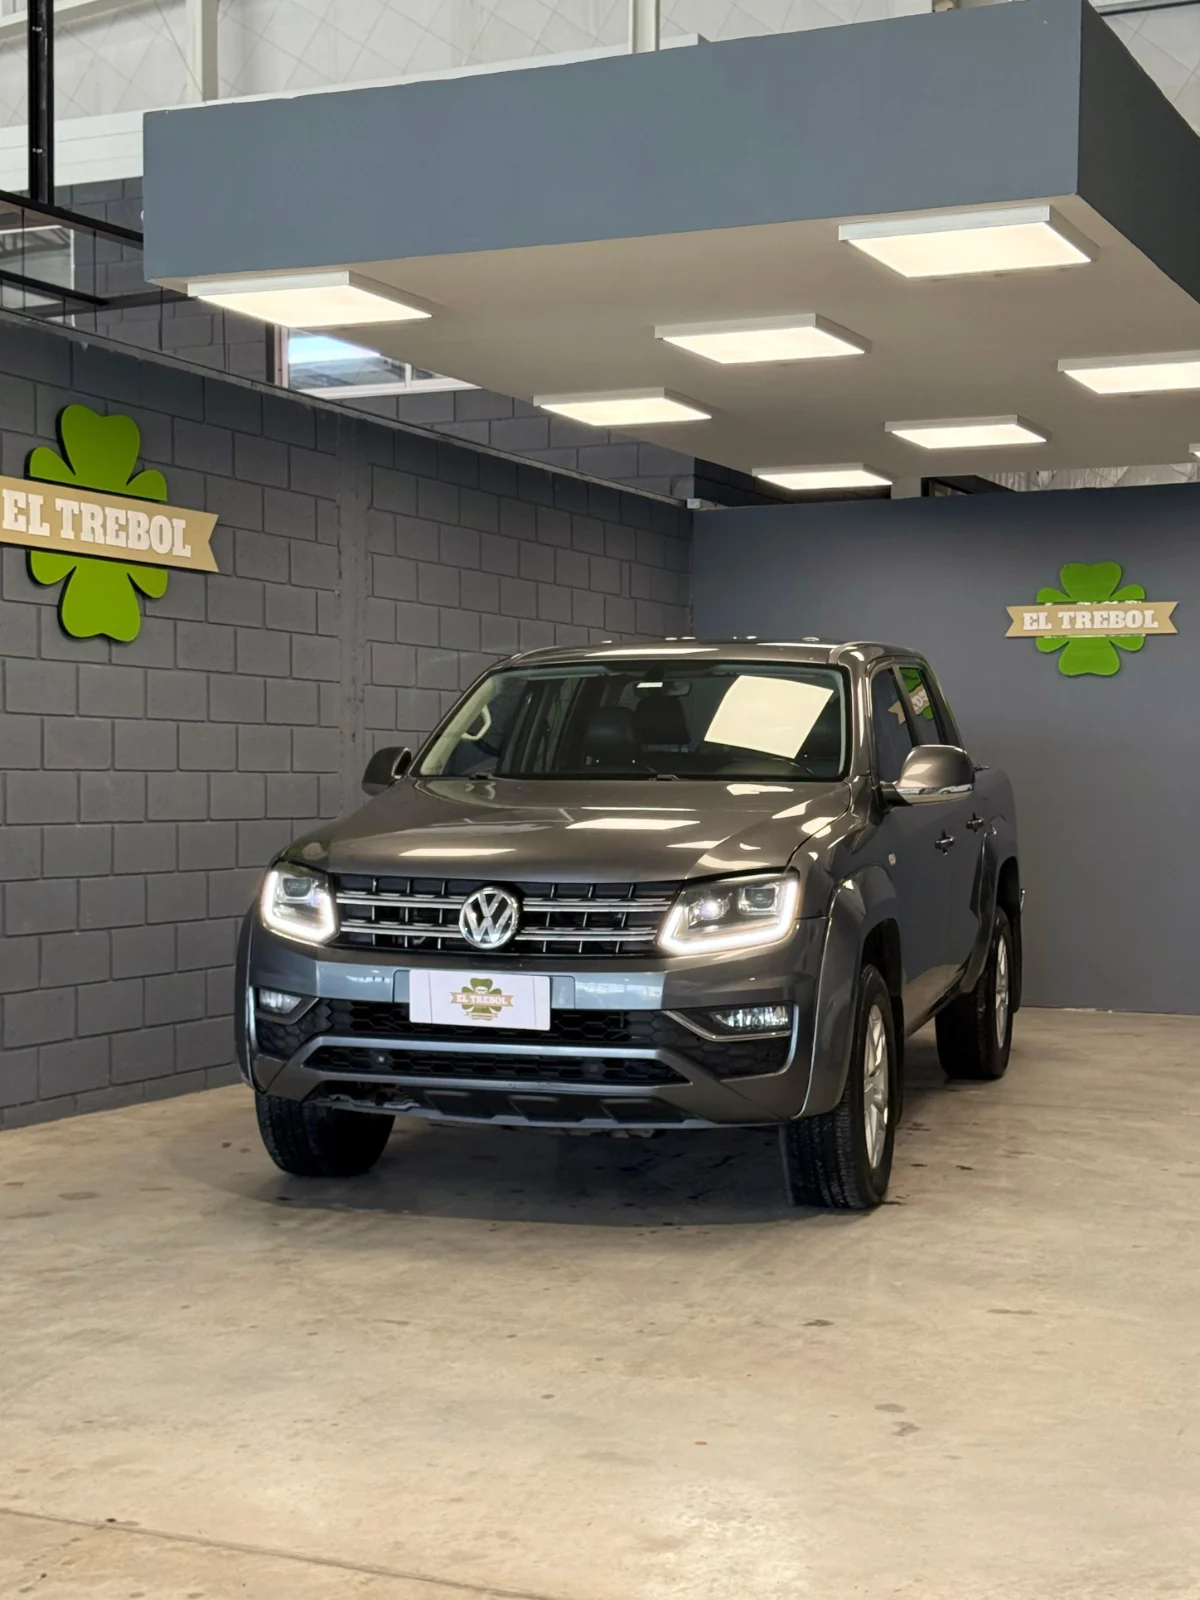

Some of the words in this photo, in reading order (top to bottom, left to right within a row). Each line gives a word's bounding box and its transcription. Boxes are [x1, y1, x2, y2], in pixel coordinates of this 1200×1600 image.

[2, 488, 51, 537] EL
[55, 497, 192, 558] TREBOL
[1023, 611, 1052, 631] EL
[1058, 609, 1159, 630] TREBOL
[456, 994, 469, 1003] EL
[469, 995, 508, 1005] TREBOL
